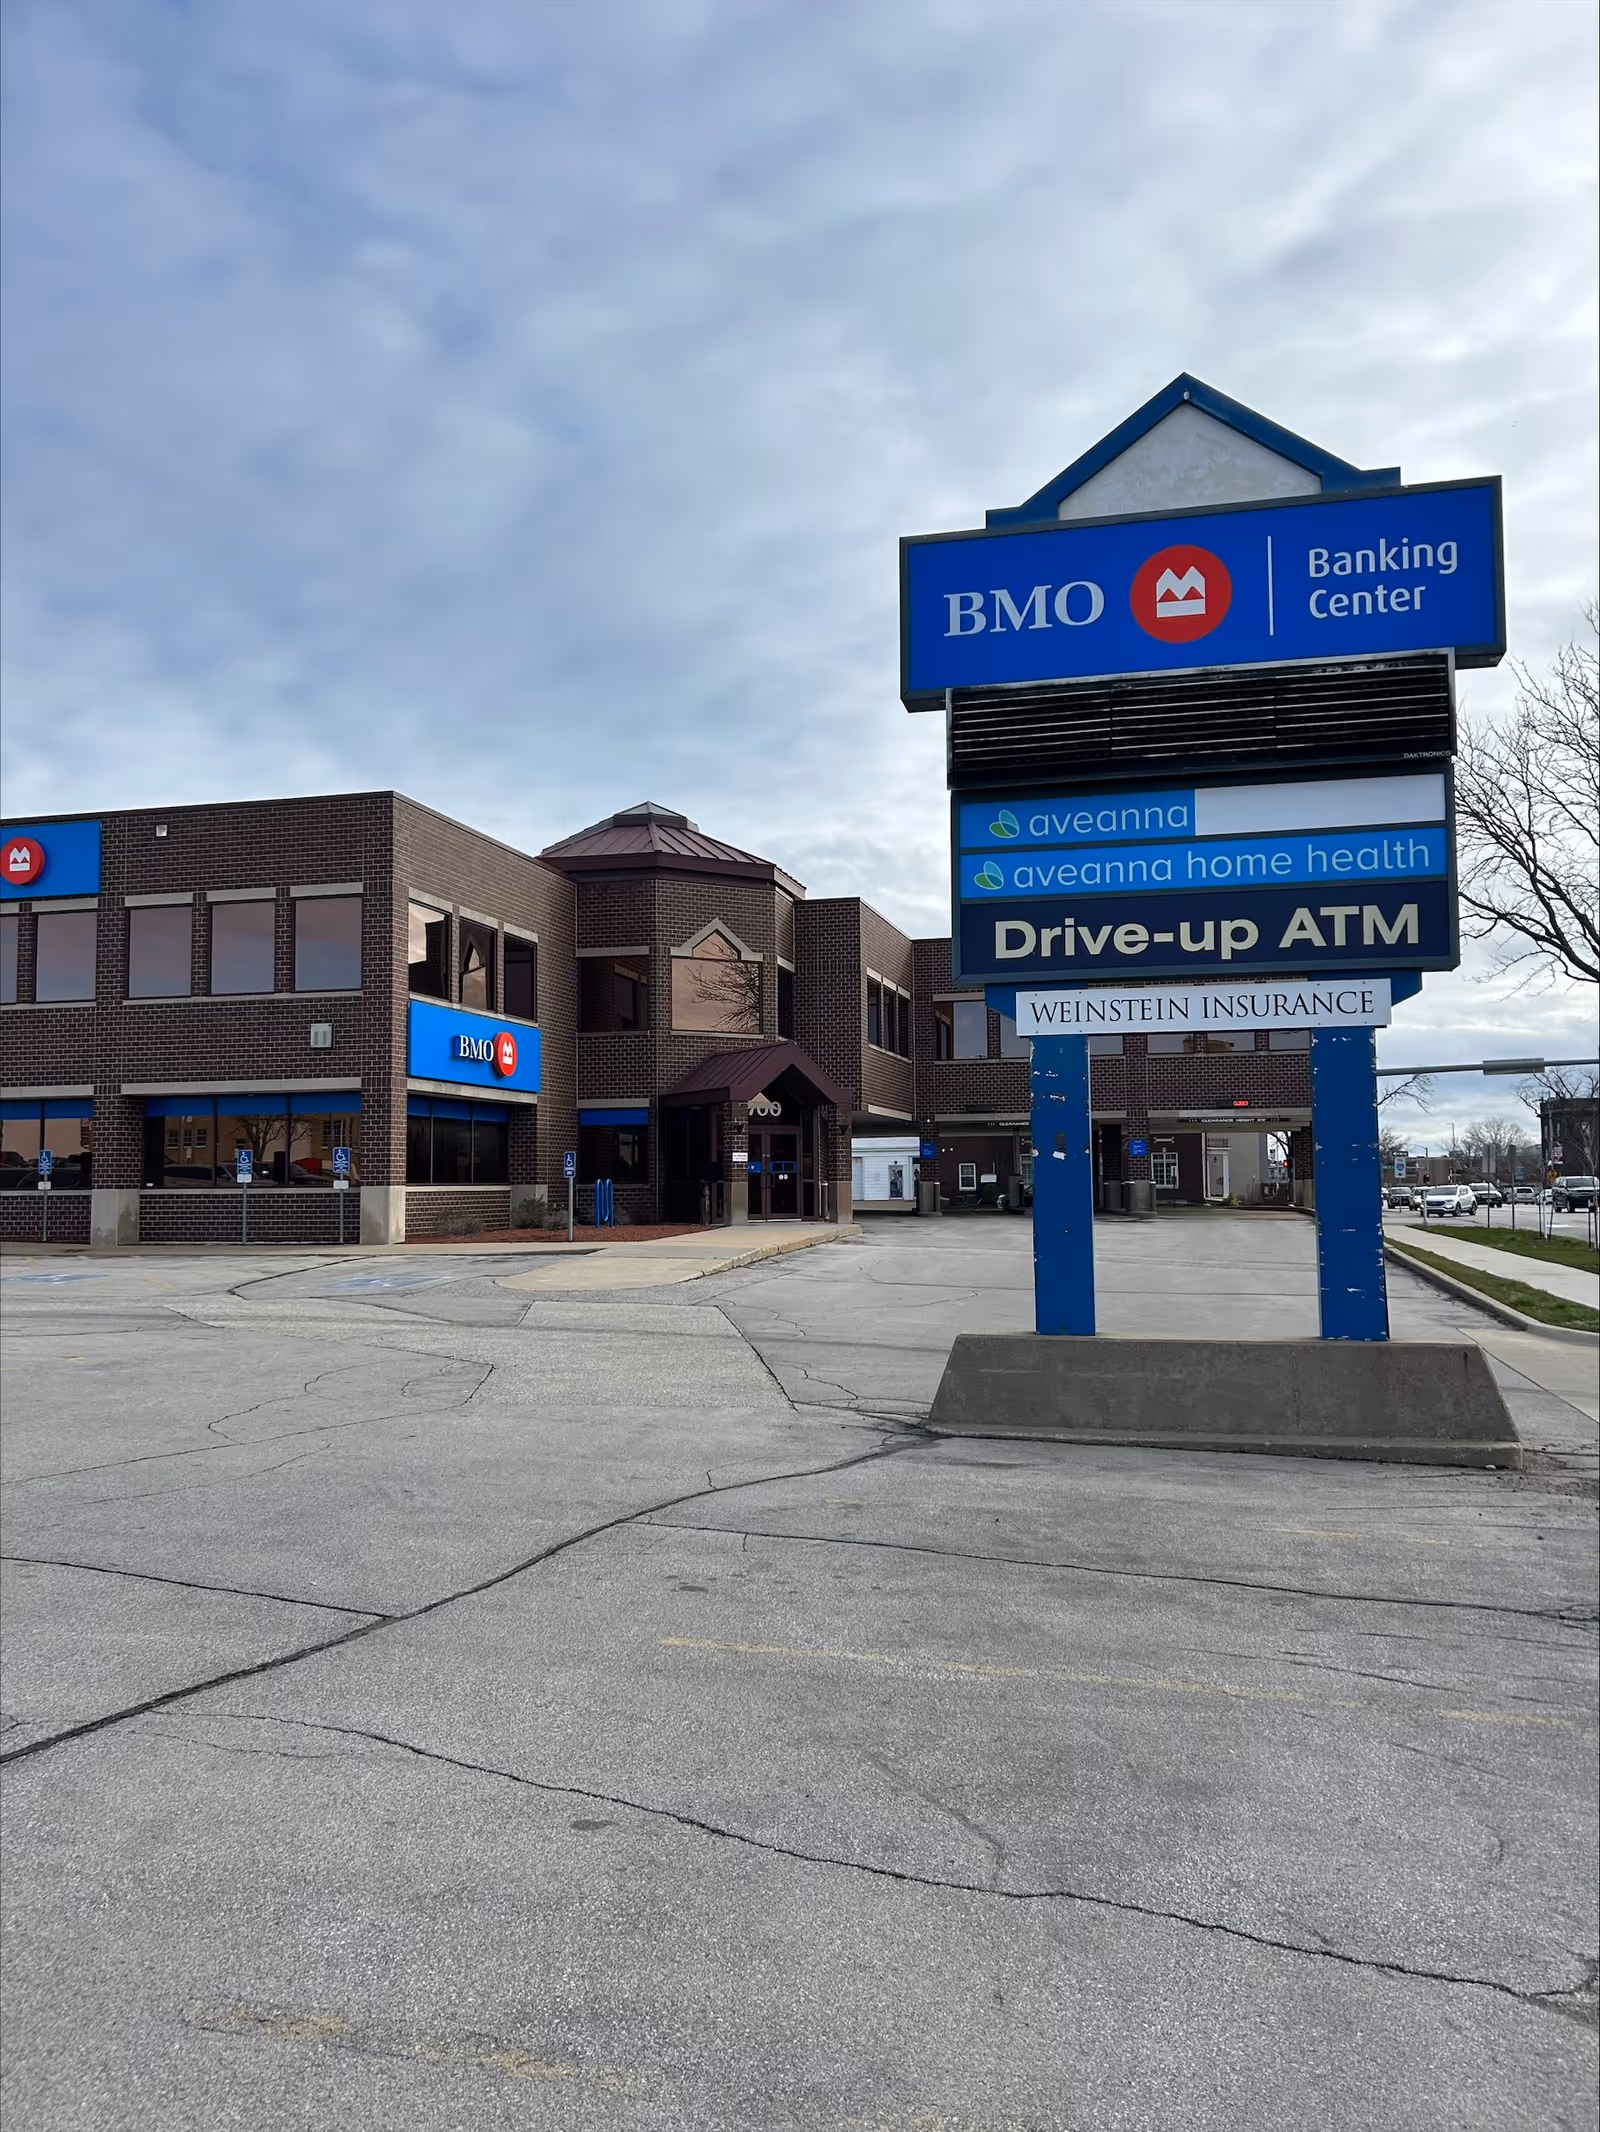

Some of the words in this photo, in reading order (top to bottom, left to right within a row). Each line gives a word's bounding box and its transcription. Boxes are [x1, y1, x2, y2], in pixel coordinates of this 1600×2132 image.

[1308, 537, 1458, 577] Banking
[944, 581, 1105, 637] BMO
[1308, 585, 1426, 619] Center
[1403, 750, 1451, 759] DAKTRONICS
[1029, 804, 1188, 837] aveanna
[1014, 857, 1172, 889] aveanna
[1187, 849, 1292, 879] home
[1307, 839, 1430, 872] health
[995, 918, 1259, 960] Drive-up
[1278, 904, 1420, 948] ATM
[1030, 997, 1191, 1025] WEINSTEIN
[1202, 991, 1375, 1018] INSURANCE
[458, 1034, 495, 1062] BMO
